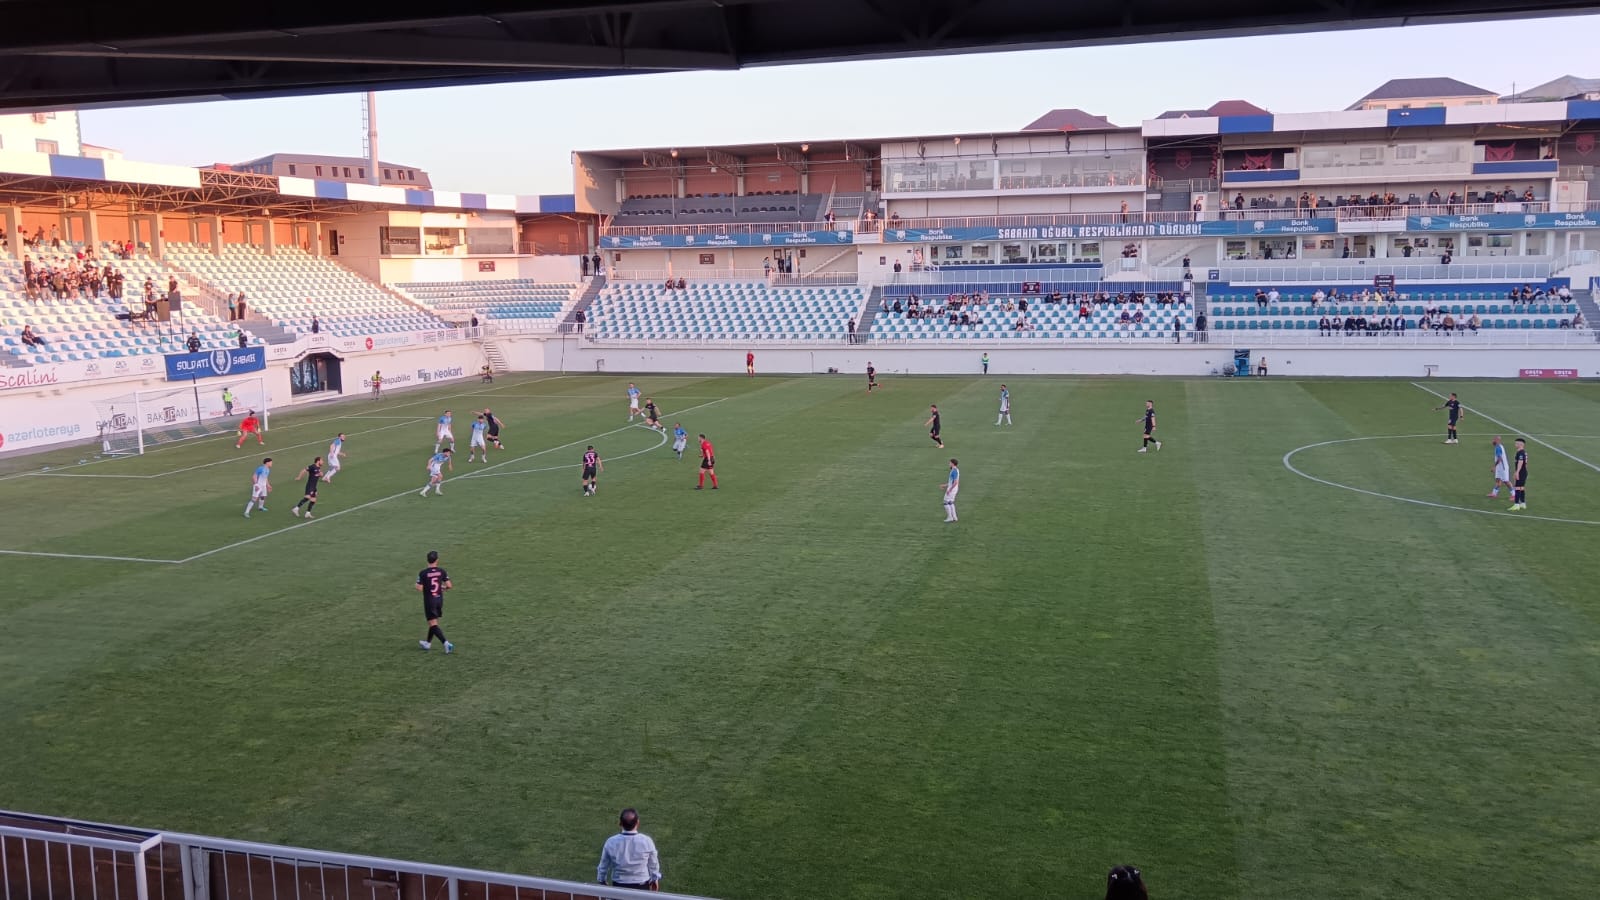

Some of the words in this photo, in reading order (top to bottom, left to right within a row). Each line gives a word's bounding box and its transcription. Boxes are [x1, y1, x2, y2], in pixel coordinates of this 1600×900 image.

[176, 358, 209, 371] SOLDATI
[232, 353, 256, 365] SABAH
[434, 367, 462, 380] Neokart
[430, 577, 439, 593] 5
